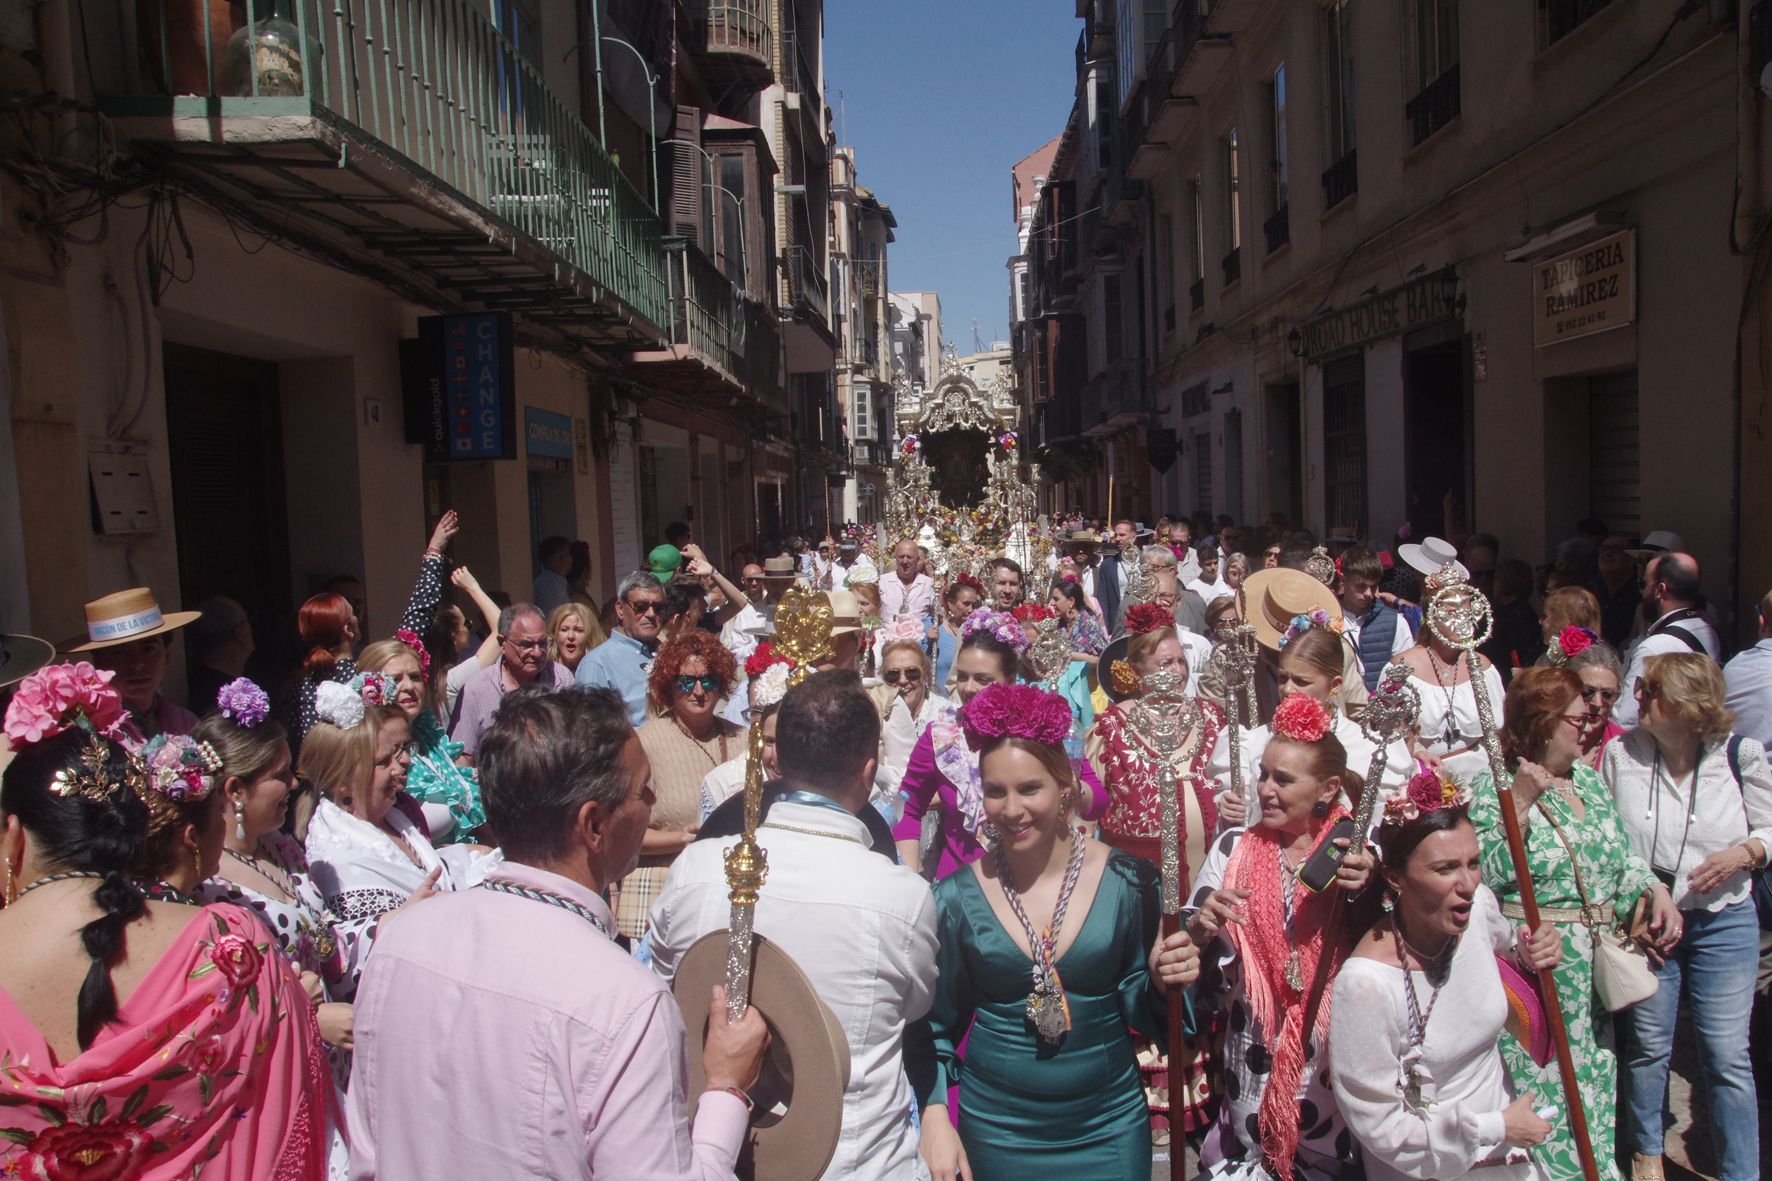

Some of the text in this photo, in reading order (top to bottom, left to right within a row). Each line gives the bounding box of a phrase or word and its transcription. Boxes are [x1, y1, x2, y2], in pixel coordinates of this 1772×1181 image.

[1541, 241, 1624, 289] TAPICERIA
[1348, 296, 1401, 341] HOUSE
[1406, 280, 1443, 322] BAR
[1546, 274, 1620, 318] RAMIREZ
[429, 377, 444, 441] quickgold
[477, 321, 495, 449] CHANGE
[116, 622, 128, 632] DE
[128, 618, 139, 629] LA
